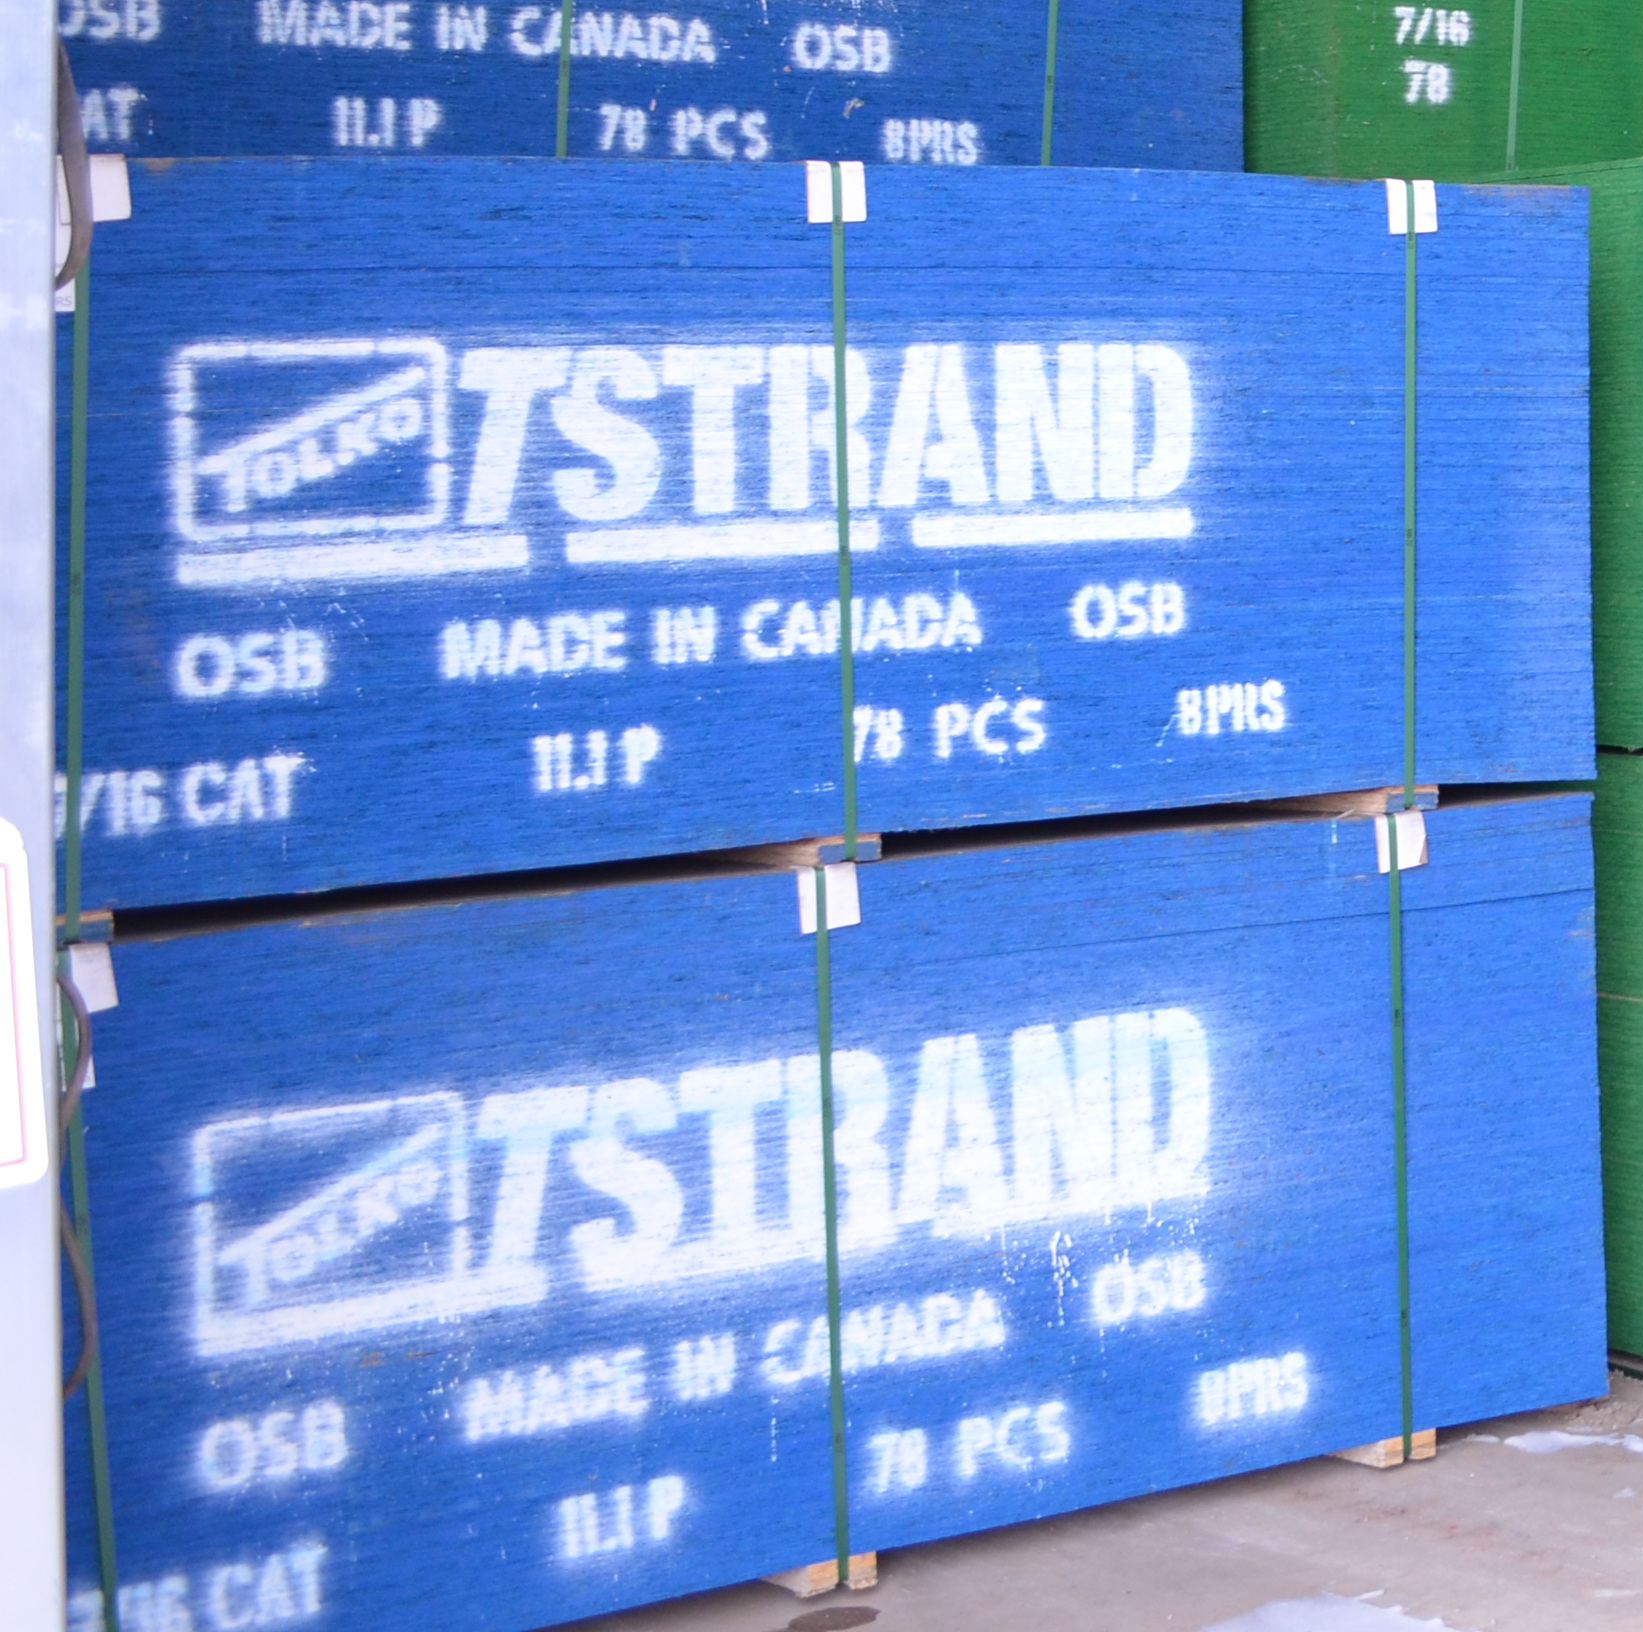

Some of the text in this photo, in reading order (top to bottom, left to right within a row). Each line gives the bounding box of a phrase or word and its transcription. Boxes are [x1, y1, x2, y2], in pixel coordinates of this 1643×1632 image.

[435, 4, 488, 51] IN
[508, 6, 716, 63] CANADA
[792, 23, 892, 73] OSB
[1394, 6, 1470, 46] 7/16
[82, 88, 140, 141] AT
[1404, 60, 1450, 103] 78
[600, 104, 771, 161] 78 PCS
[206, 398, 425, 513] TOLKO
[456, 340, 1195, 528] TSTRAND
[439, 592, 982, 678] MADE IN CANADA
[1068, 580, 1186, 639] OSB
[175, 630, 330, 702] OSB
[853, 694, 1047, 762] 78 PCS
[183, 755, 305, 826] CAT
[474, 1006, 1212, 1294] TSTRAND
[1090, 1256, 1204, 1325] OSB
[674, 1332, 736, 1396] IN
[196, 1397, 350, 1492] OSB
[868, 1402, 1073, 1493] 78 PCS
[208, 1544, 328, 1630] CAT
